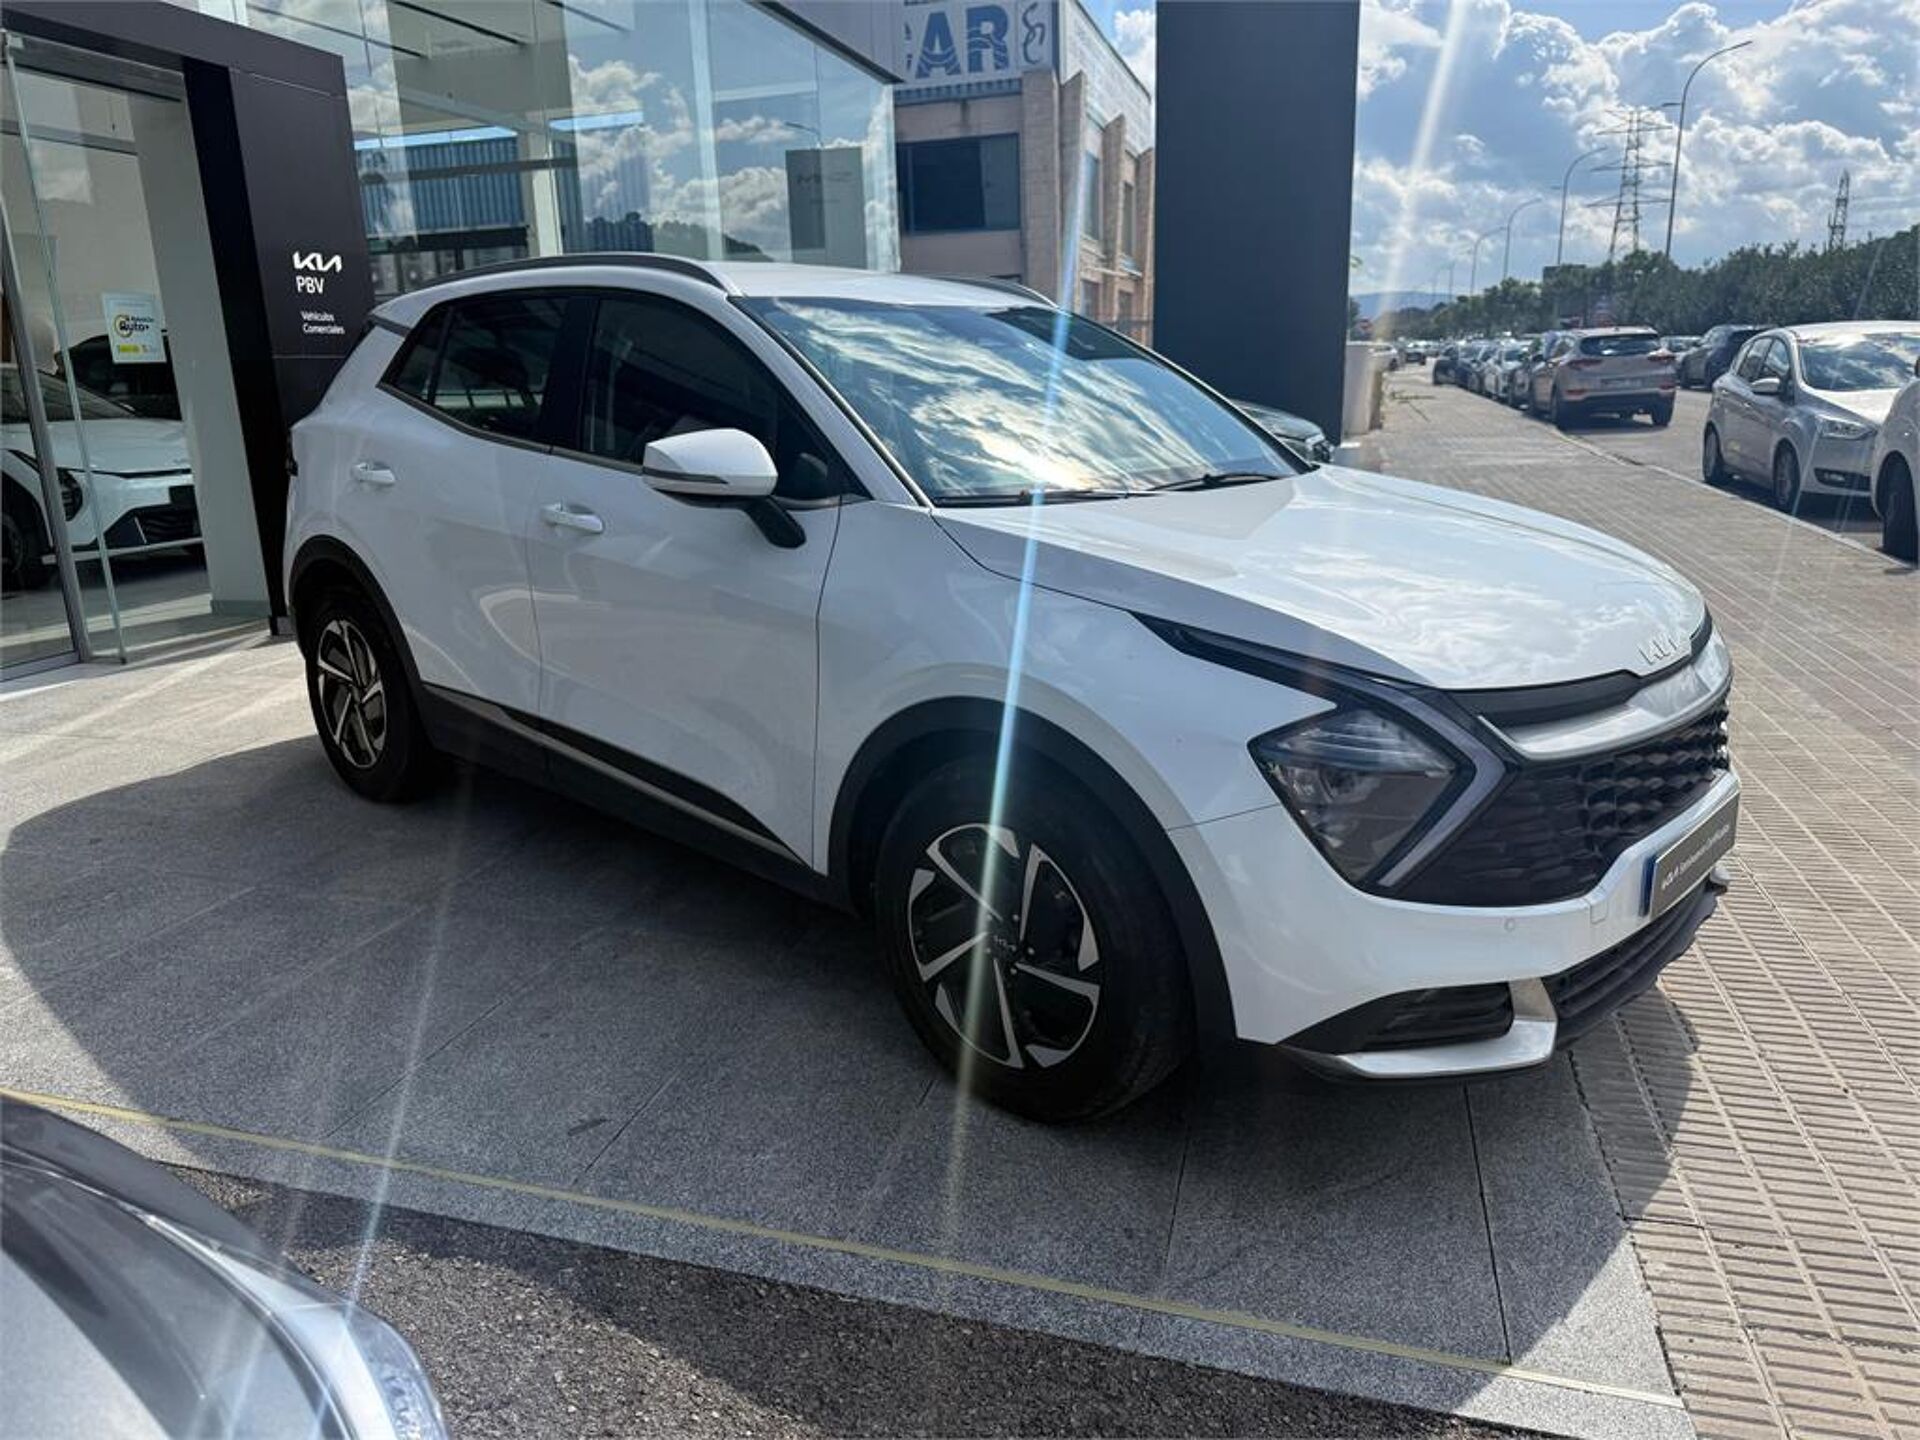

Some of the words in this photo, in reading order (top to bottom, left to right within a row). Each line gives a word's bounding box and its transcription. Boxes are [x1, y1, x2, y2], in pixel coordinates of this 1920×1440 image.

[904, 5, 1009, 79] AR
[293, 251, 342, 273] KIA
[296, 275, 325, 294] PBV
[303, 322, 345, 335] Comerciales
